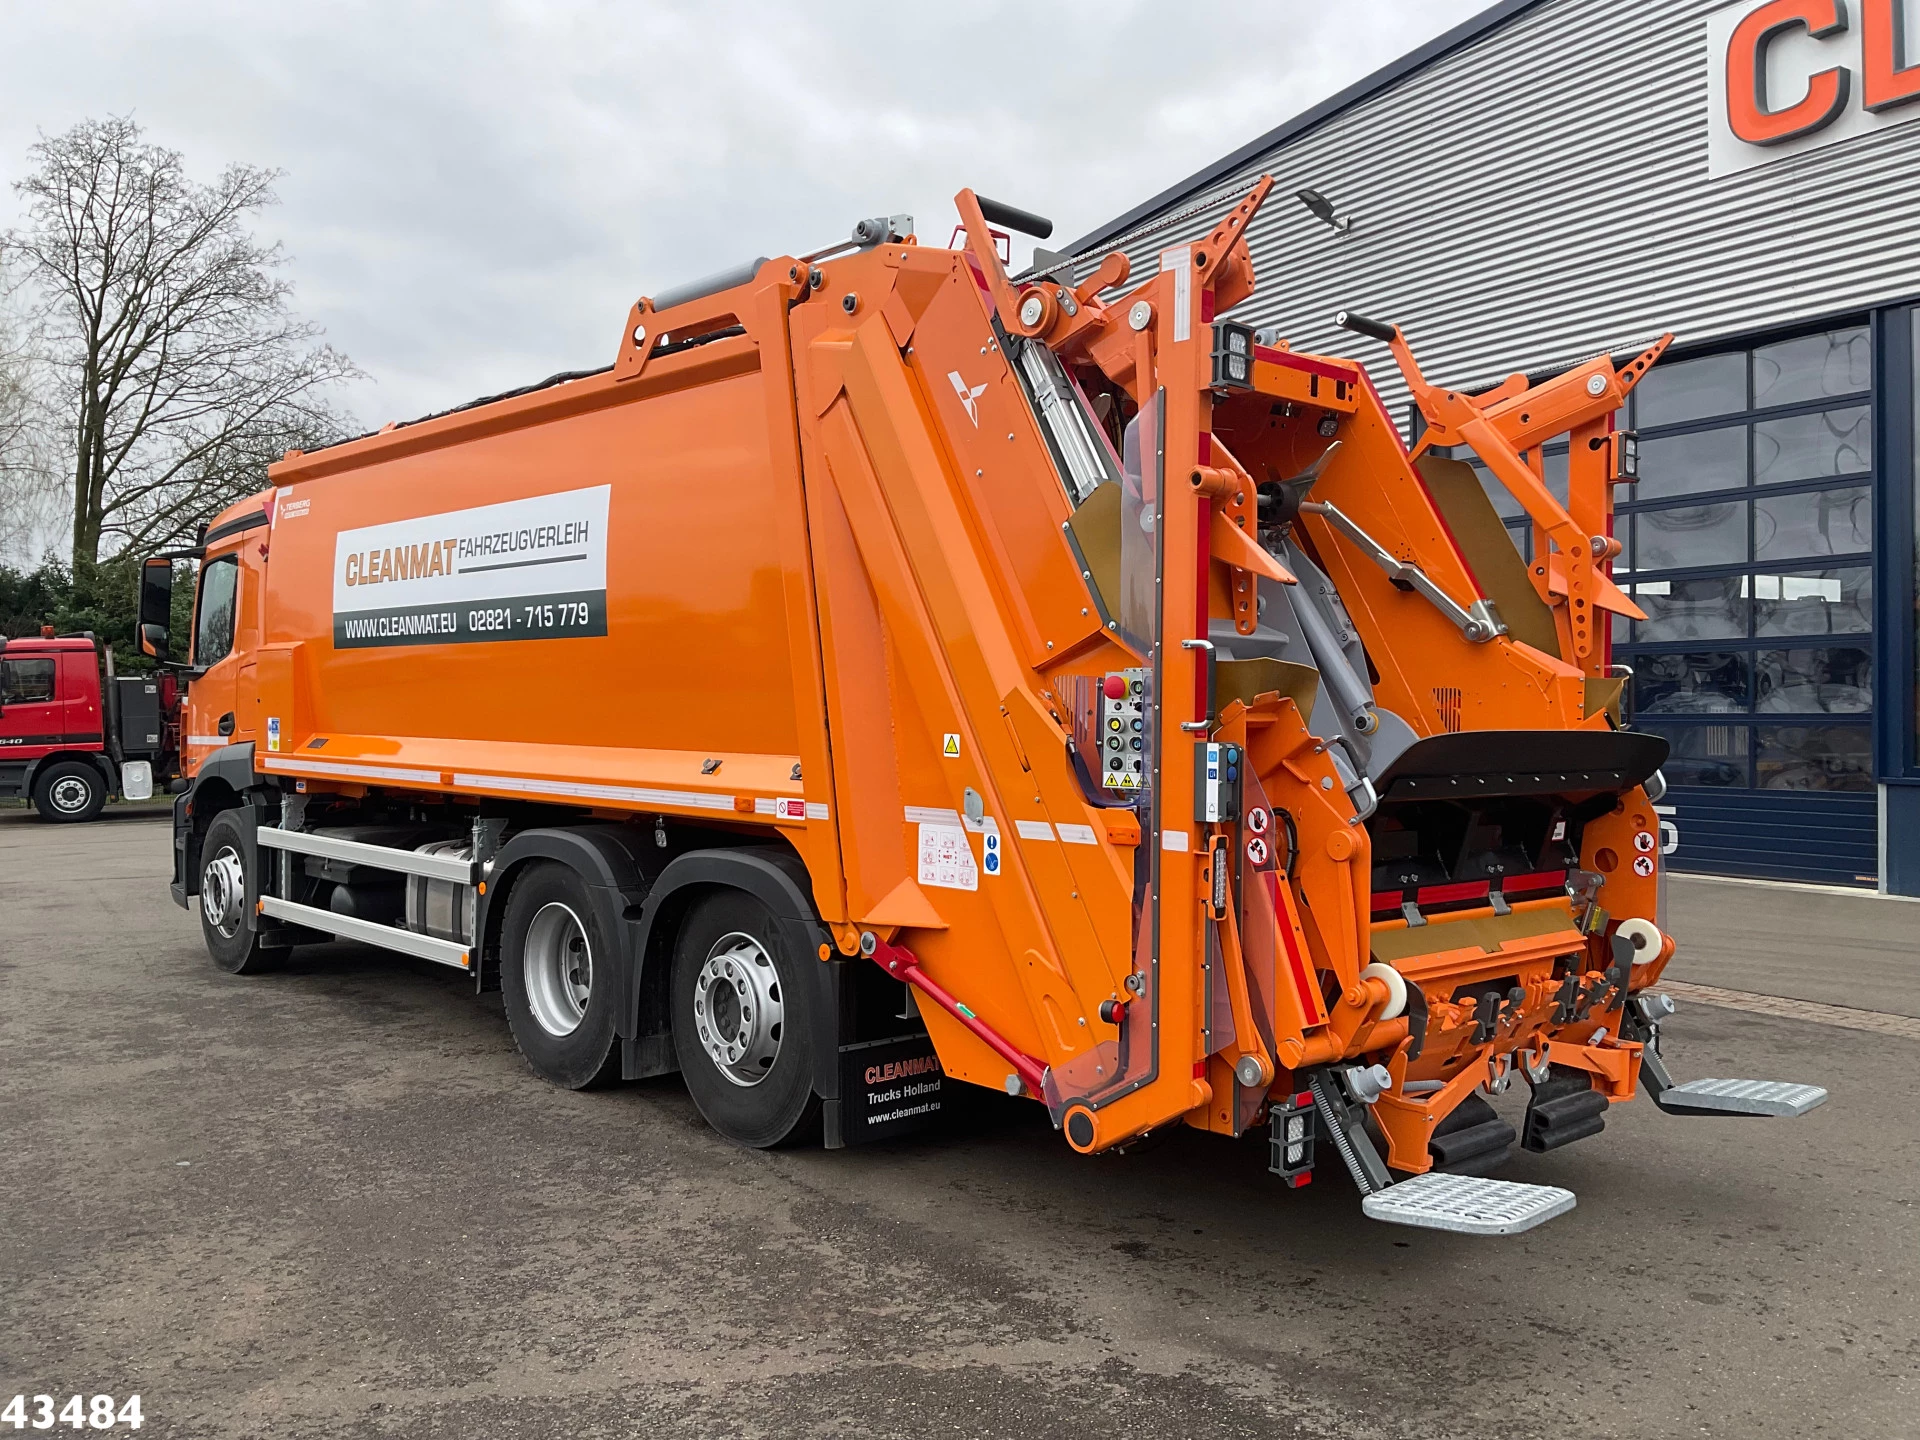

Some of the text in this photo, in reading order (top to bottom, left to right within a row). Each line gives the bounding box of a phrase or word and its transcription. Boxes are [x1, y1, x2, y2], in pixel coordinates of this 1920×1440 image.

[345, 520, 589, 587] CLEANMAT FAHRZEUGVERLEIH
[345, 612, 457, 639] WWW.CLEANMAT.EU
[469, 608, 512, 632] 02821
[525, 604, 553, 628] 715
[558, 602, 588, 626] 779
[867, 1079, 941, 1105] Trucks Holland
[867, 1101, 941, 1125] www.cleanmat.eu
